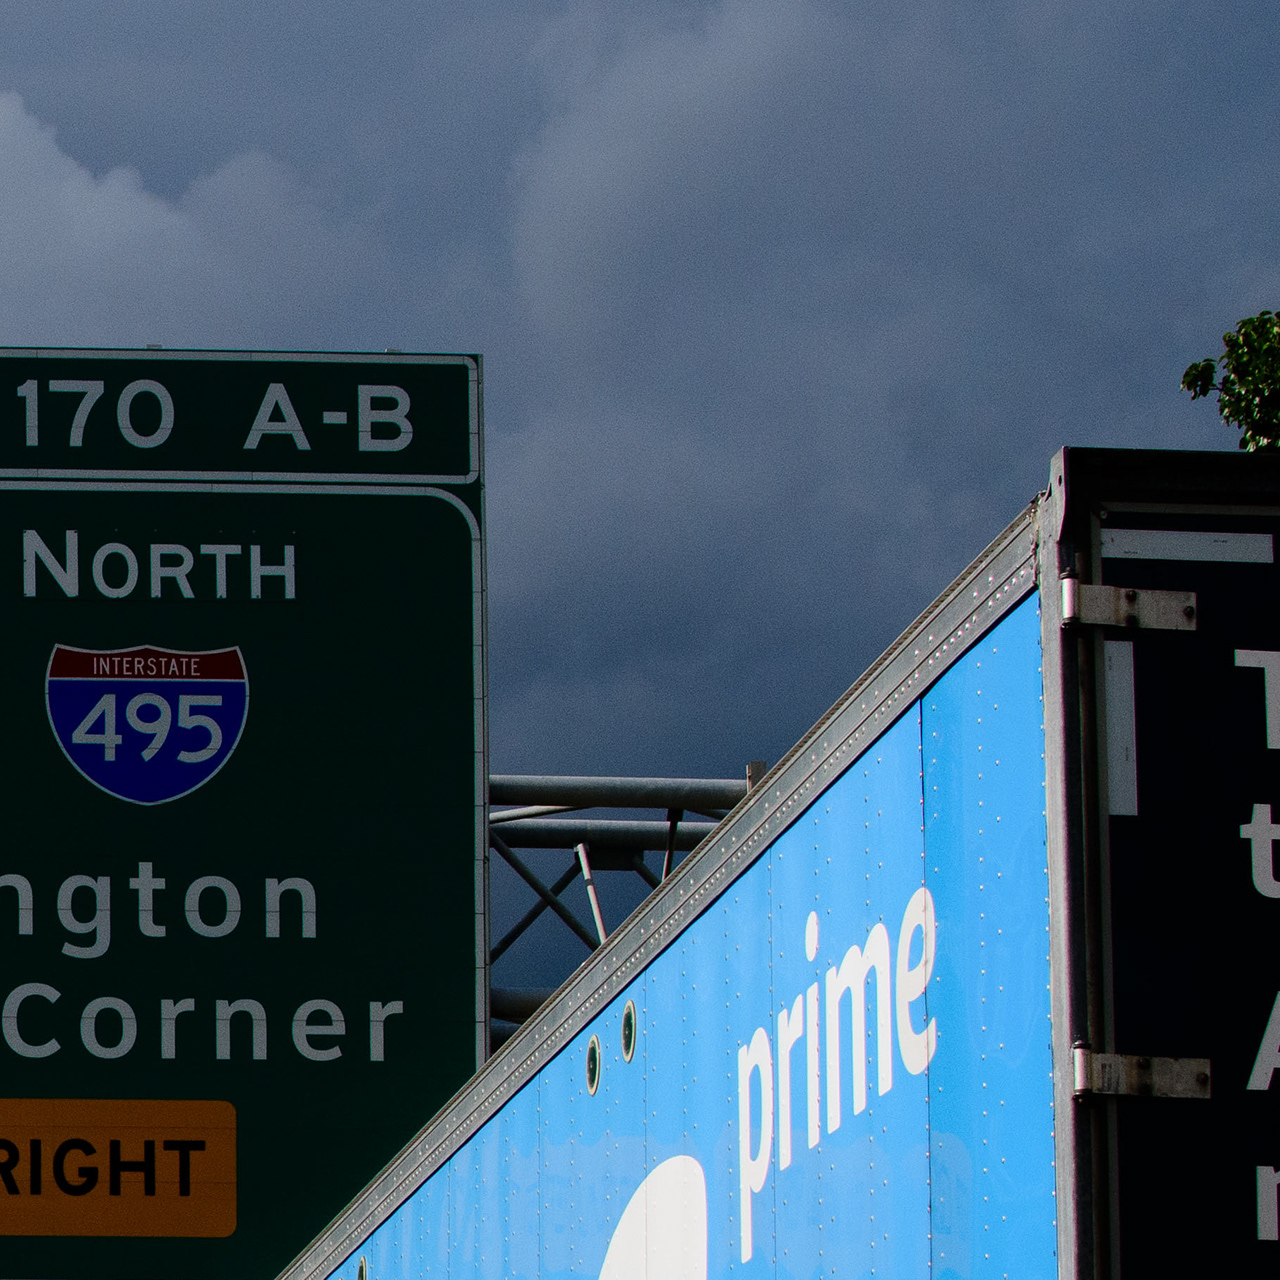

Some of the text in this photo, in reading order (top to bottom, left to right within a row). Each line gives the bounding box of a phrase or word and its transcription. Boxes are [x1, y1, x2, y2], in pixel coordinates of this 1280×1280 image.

[18, 379, 174, 447] 170
[245, 383, 413, 450] A-B
[24, 530, 295, 598] NORTH
[93, 656, 202, 678] INTERSTATE
[70, 693, 224, 763] 495
[3, 983, 403, 1061] Corner
[738, 887, 938, 1263] prime
